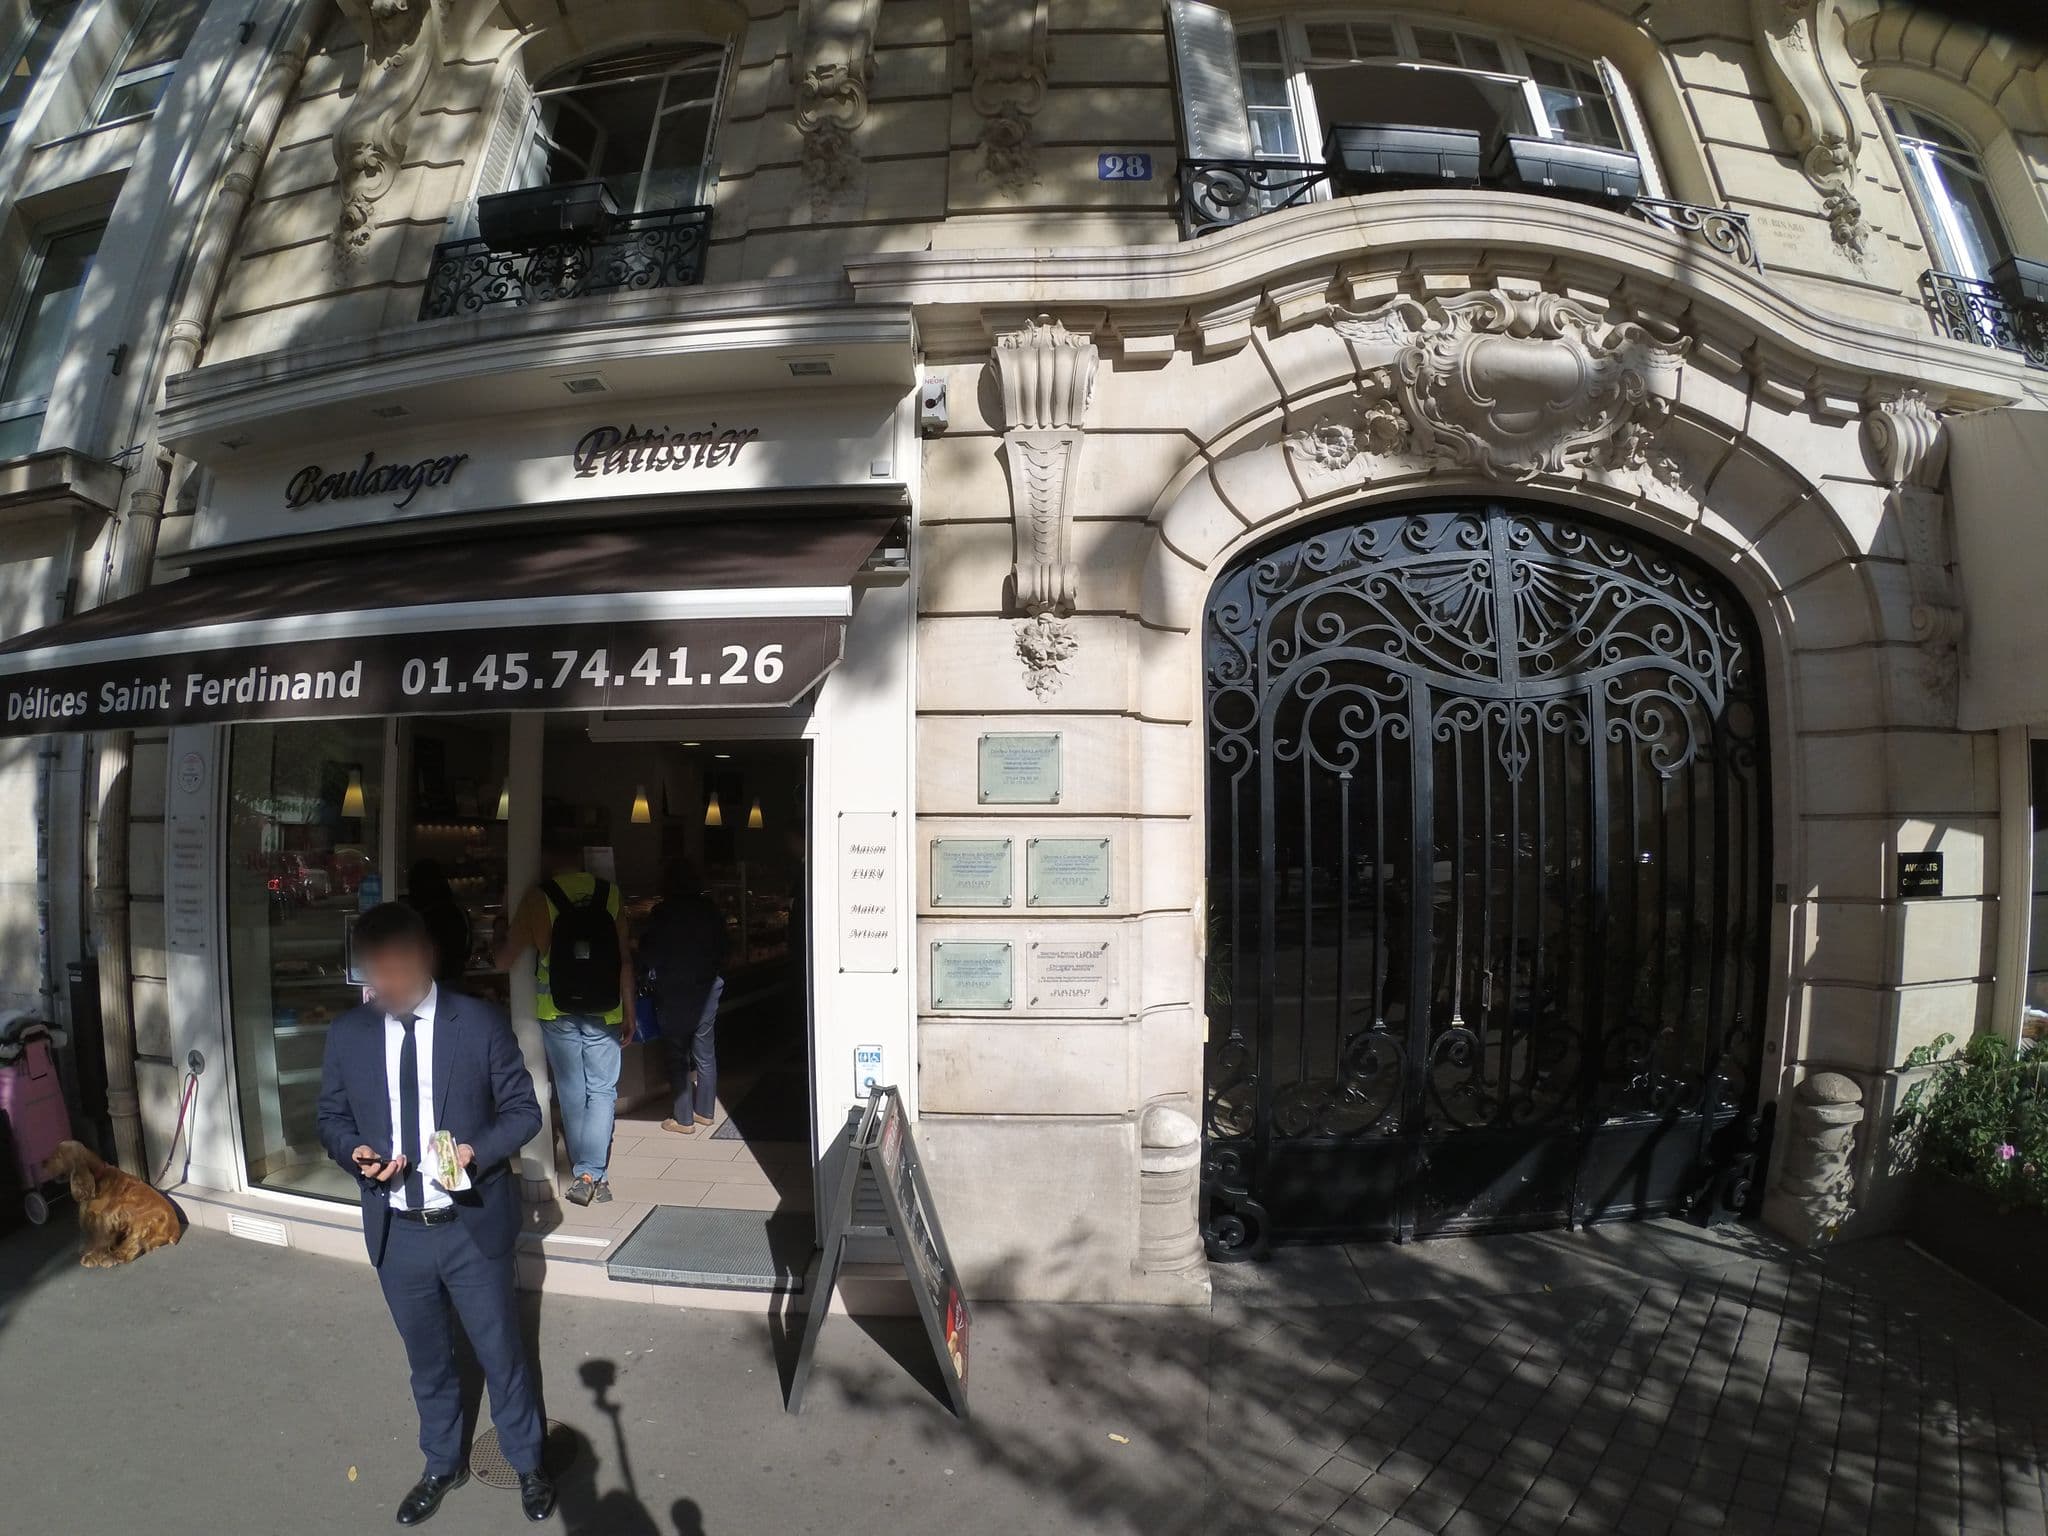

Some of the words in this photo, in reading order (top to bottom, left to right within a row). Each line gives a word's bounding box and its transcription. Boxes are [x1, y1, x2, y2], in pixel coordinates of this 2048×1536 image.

[1105, 156, 1144, 178] 28
[285, 451, 469, 509] Boulanger
[574, 421, 760, 479] Pâtissier
[7, 686, 88, 721] Délices
[99, 677, 171, 713] Saint
[185, 660, 364, 707] Ferdinand
[401, 643, 785, 695] 01.45.74.41.26
[849, 843, 887, 854] Maison
[848, 928, 889, 939] Artisan
